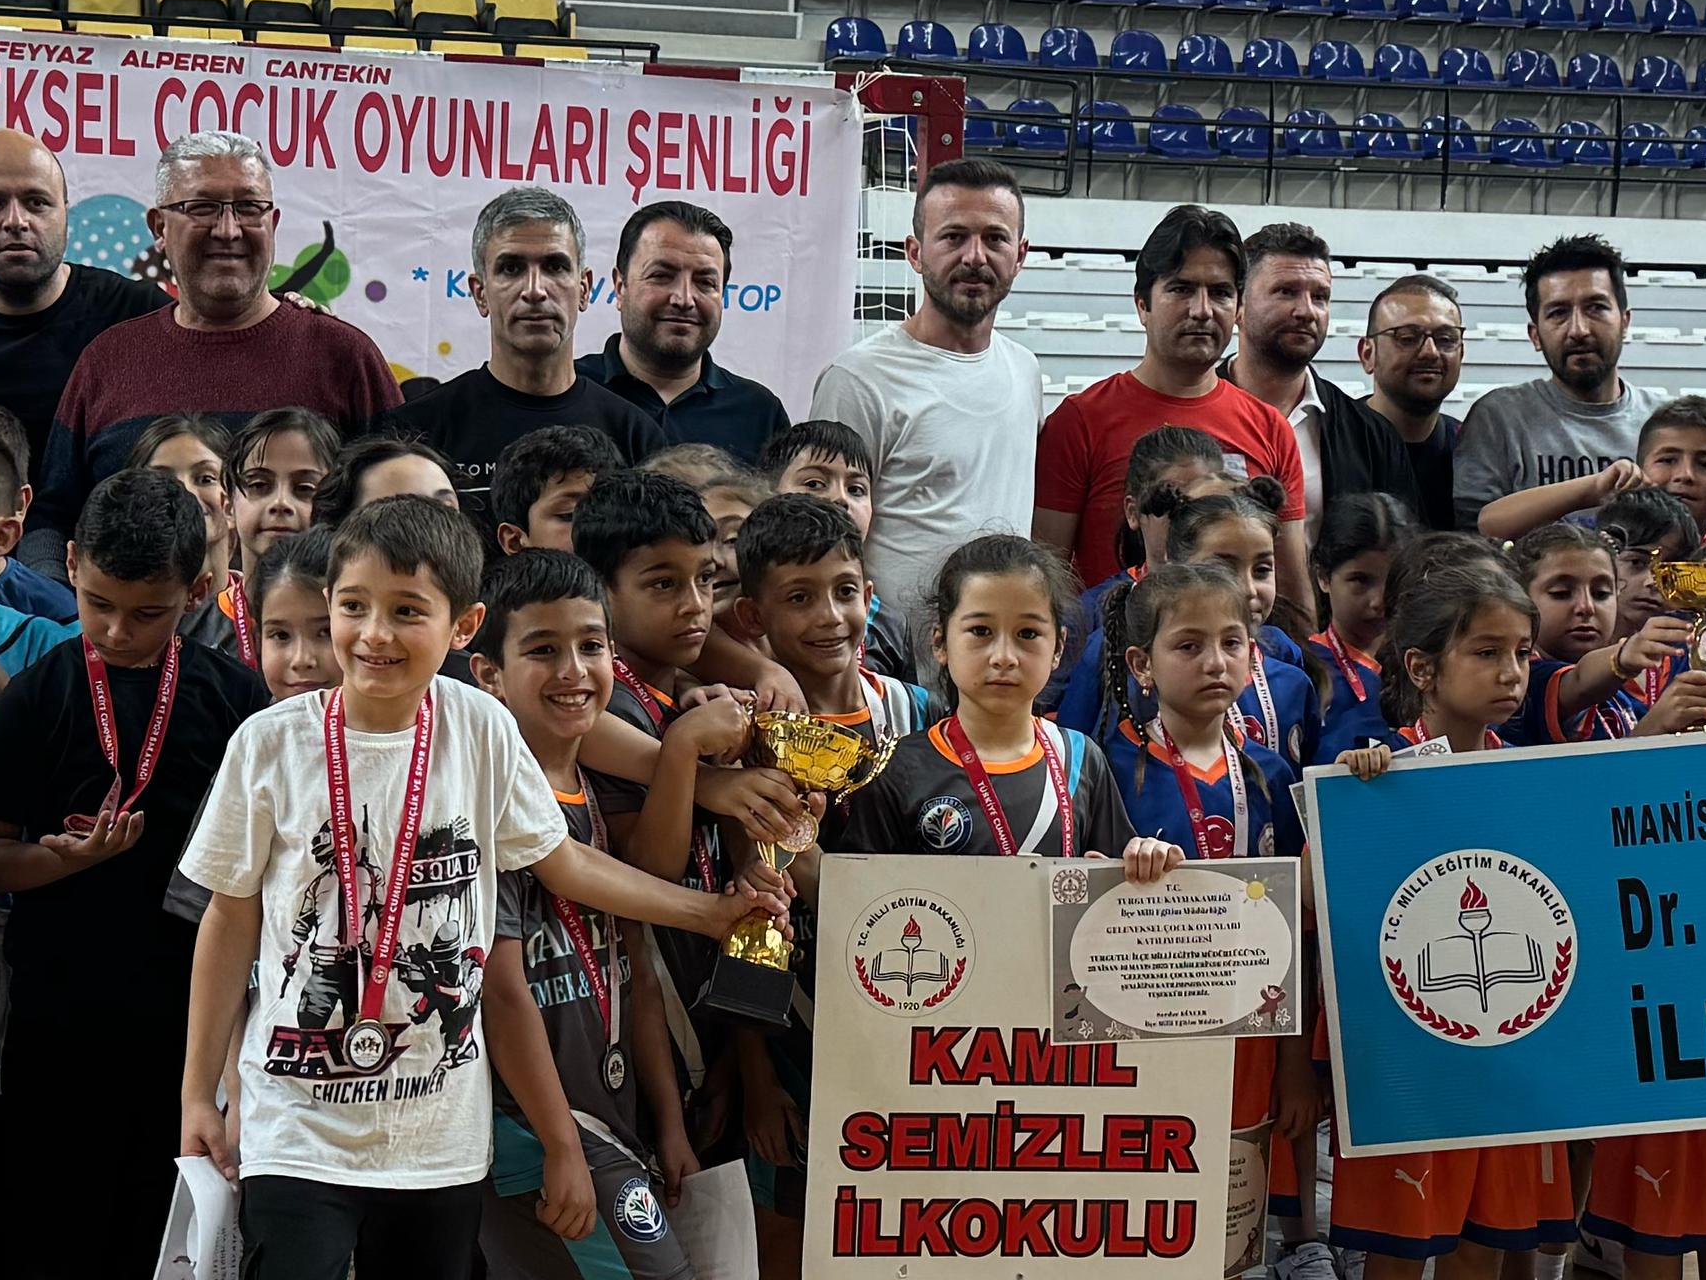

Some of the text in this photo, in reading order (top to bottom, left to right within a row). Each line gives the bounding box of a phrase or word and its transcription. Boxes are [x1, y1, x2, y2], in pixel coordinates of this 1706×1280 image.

[120, 49, 245, 75] ALPEREN
[265, 58, 392, 86] CANTEKİN
[353, 90, 609, 187] OYUNLARI
[627, 94, 812, 205] ŞENLİĞİ
[411, 856, 477, 883] SQUAD
[1384, 853, 1568, 942] T.C. MİLLİ EĞİTİM BAKANLIĞI
[891, 897, 928, 911] EĞİTİM
[928, 901, 967, 950] BAKANLIĞI
[1617, 875, 1696, 951] Dr.
[897, 1001, 920, 1011] 1920
[313, 1078, 388, 1105] CHICKEN
[839, 1100, 1200, 1173] SEMİZLER
[832, 1185, 1198, 1258] İLKOKULU
